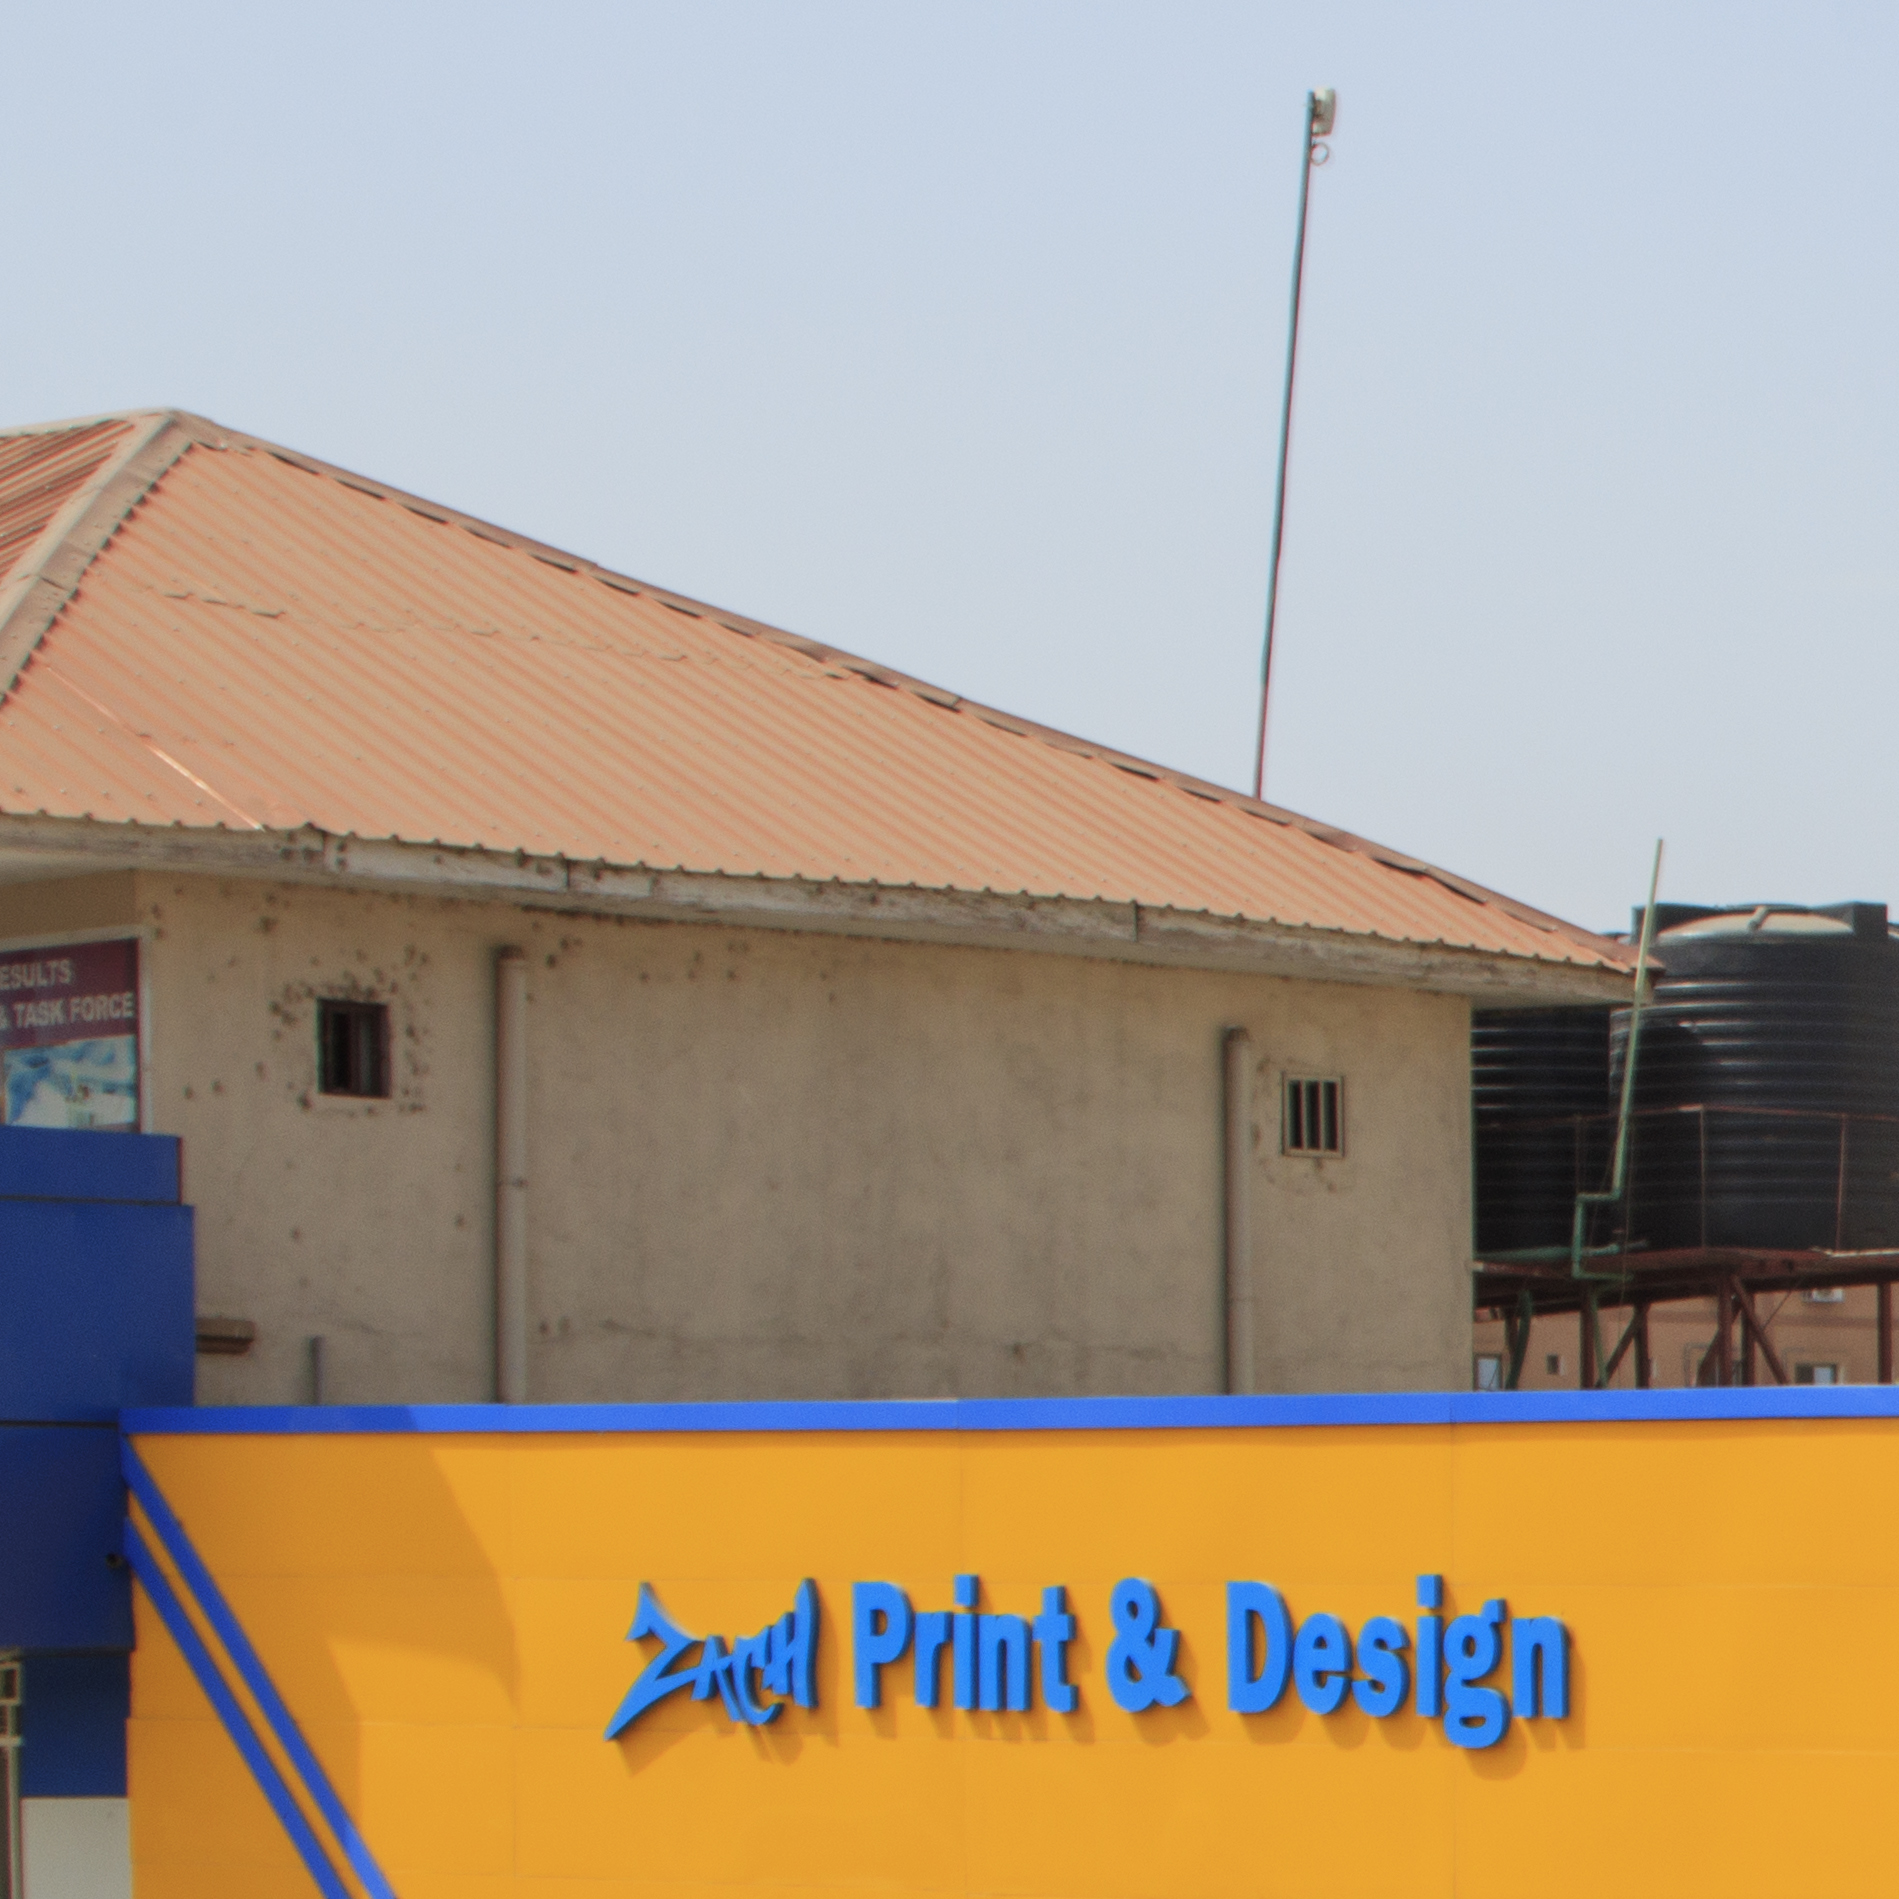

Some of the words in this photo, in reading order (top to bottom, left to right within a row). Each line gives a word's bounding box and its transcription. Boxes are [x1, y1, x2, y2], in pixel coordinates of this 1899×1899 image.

[13, 998, 66, 1029] TASK
[70, 991, 134, 1022] FORCE
[851, 1573, 1079, 1713] Print
[1105, 1577, 1191, 1714] &
[1226, 1574, 1569, 1750] Design
